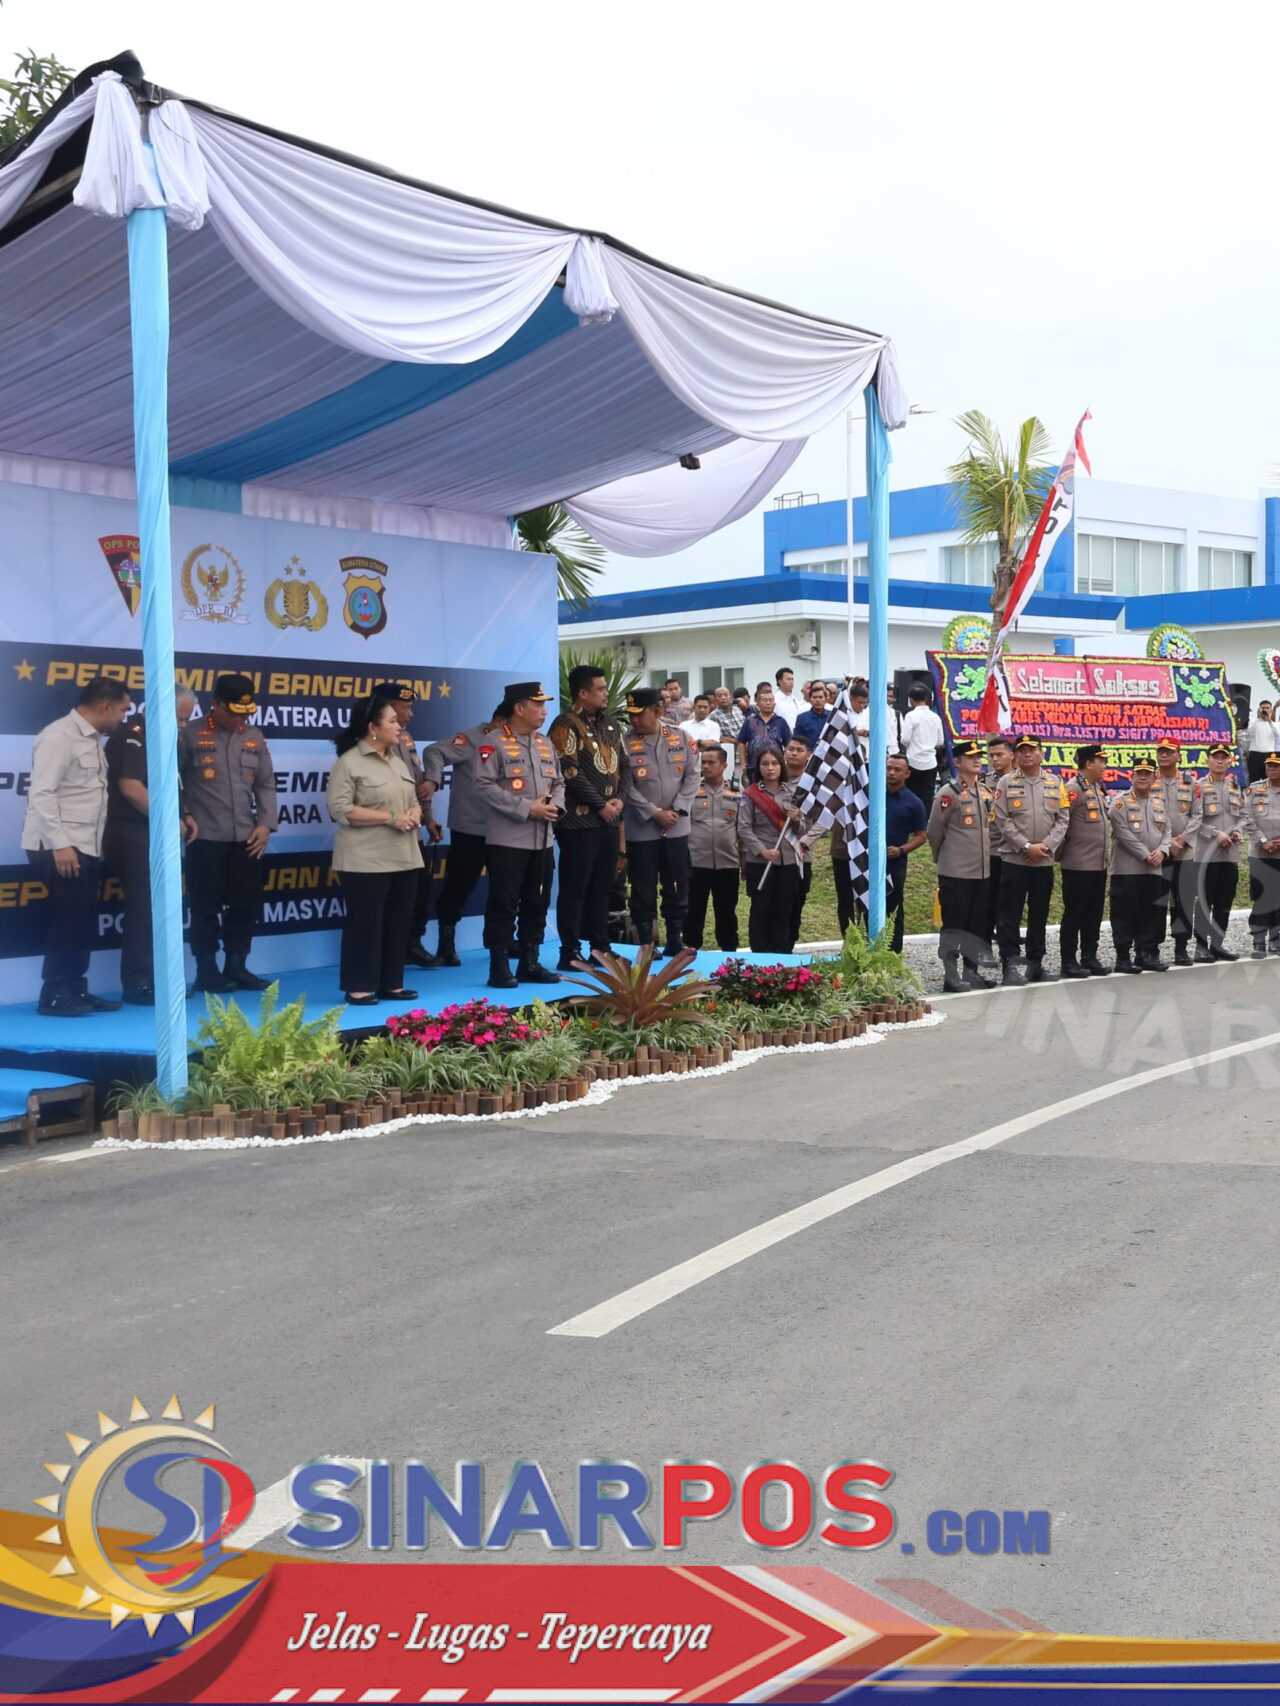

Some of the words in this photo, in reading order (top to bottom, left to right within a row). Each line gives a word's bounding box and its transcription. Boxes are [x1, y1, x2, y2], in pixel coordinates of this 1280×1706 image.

[267, 672, 432, 701] BANGUAN
[1016, 667, 1087, 695] Selamat
[1093, 668, 1160, 697] Sukses
